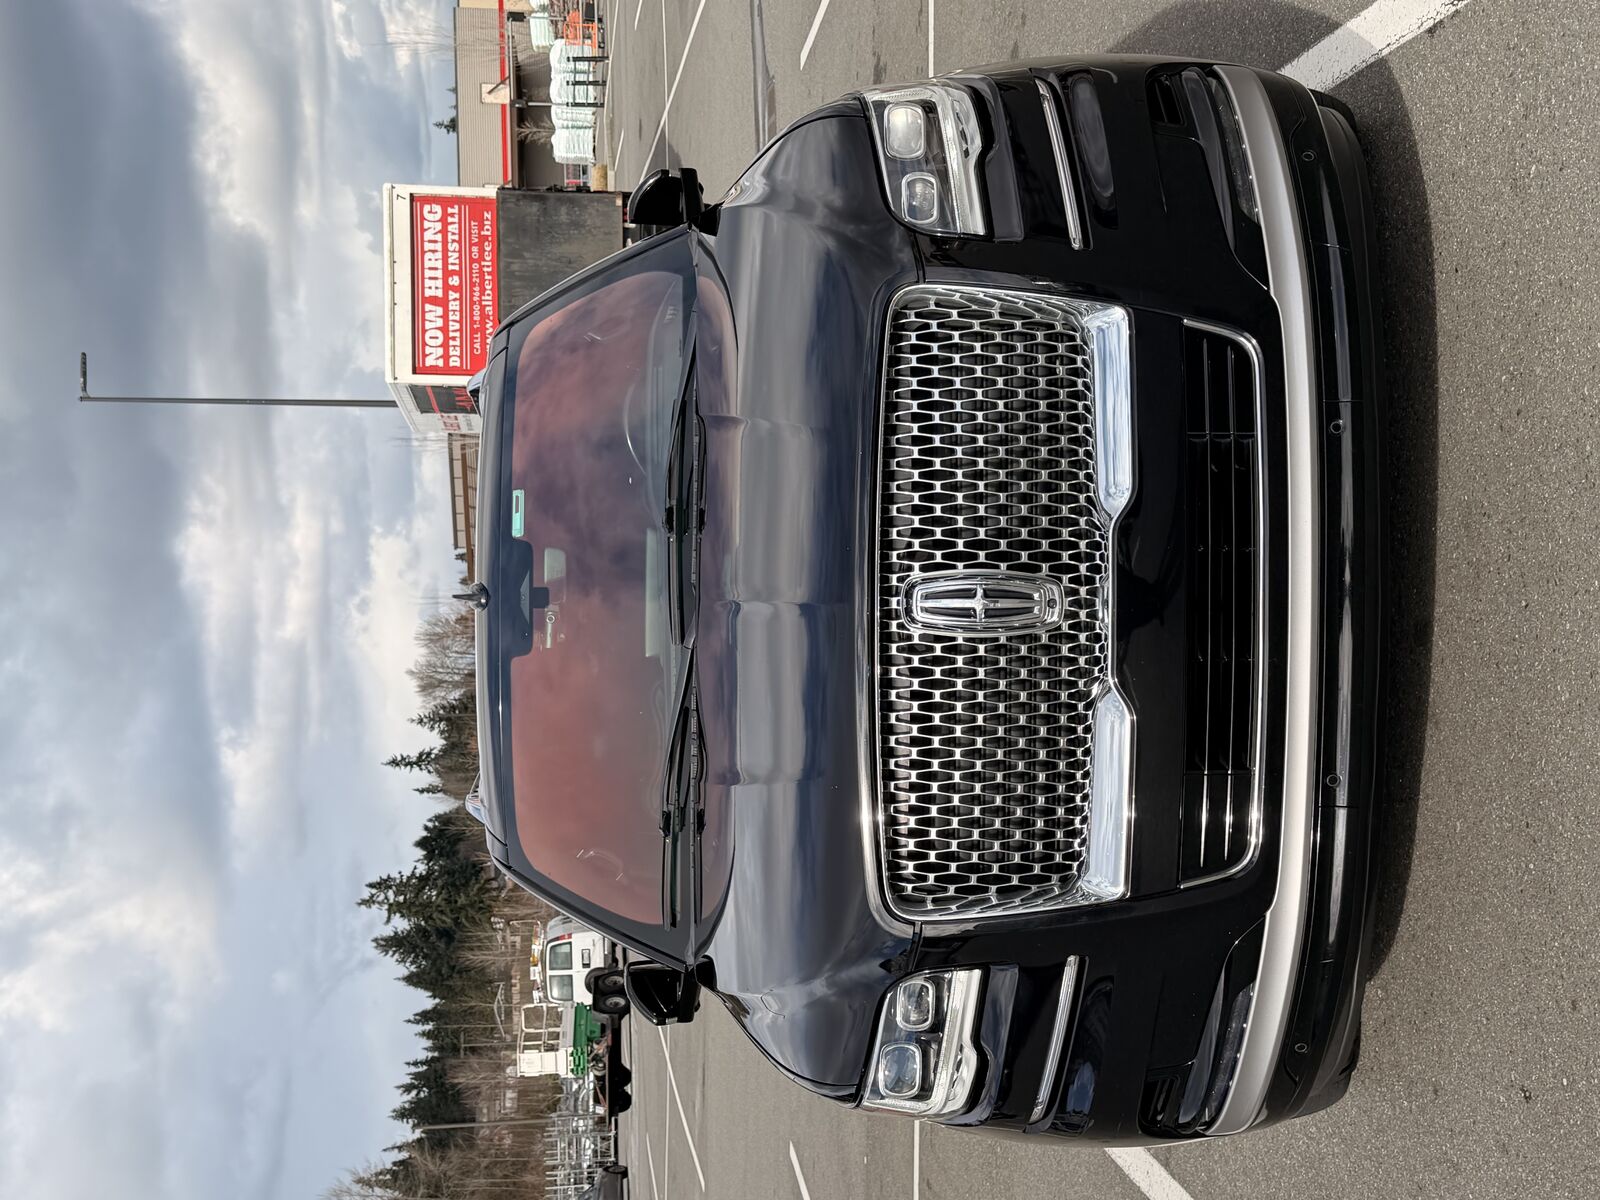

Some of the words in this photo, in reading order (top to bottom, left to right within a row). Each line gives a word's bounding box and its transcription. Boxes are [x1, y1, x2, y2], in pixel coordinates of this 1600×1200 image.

[423, 204, 443, 297] HIRING
[447, 205, 459, 270] INSTALL
[472, 247, 479, 258] OR
[449, 276, 459, 286] &
[472, 263, 480, 328] 1-800-966-2110
[424, 304, 443, 367] NOW
[448, 291, 460, 367] DELIVERY
[472, 332, 481, 354] CALL
